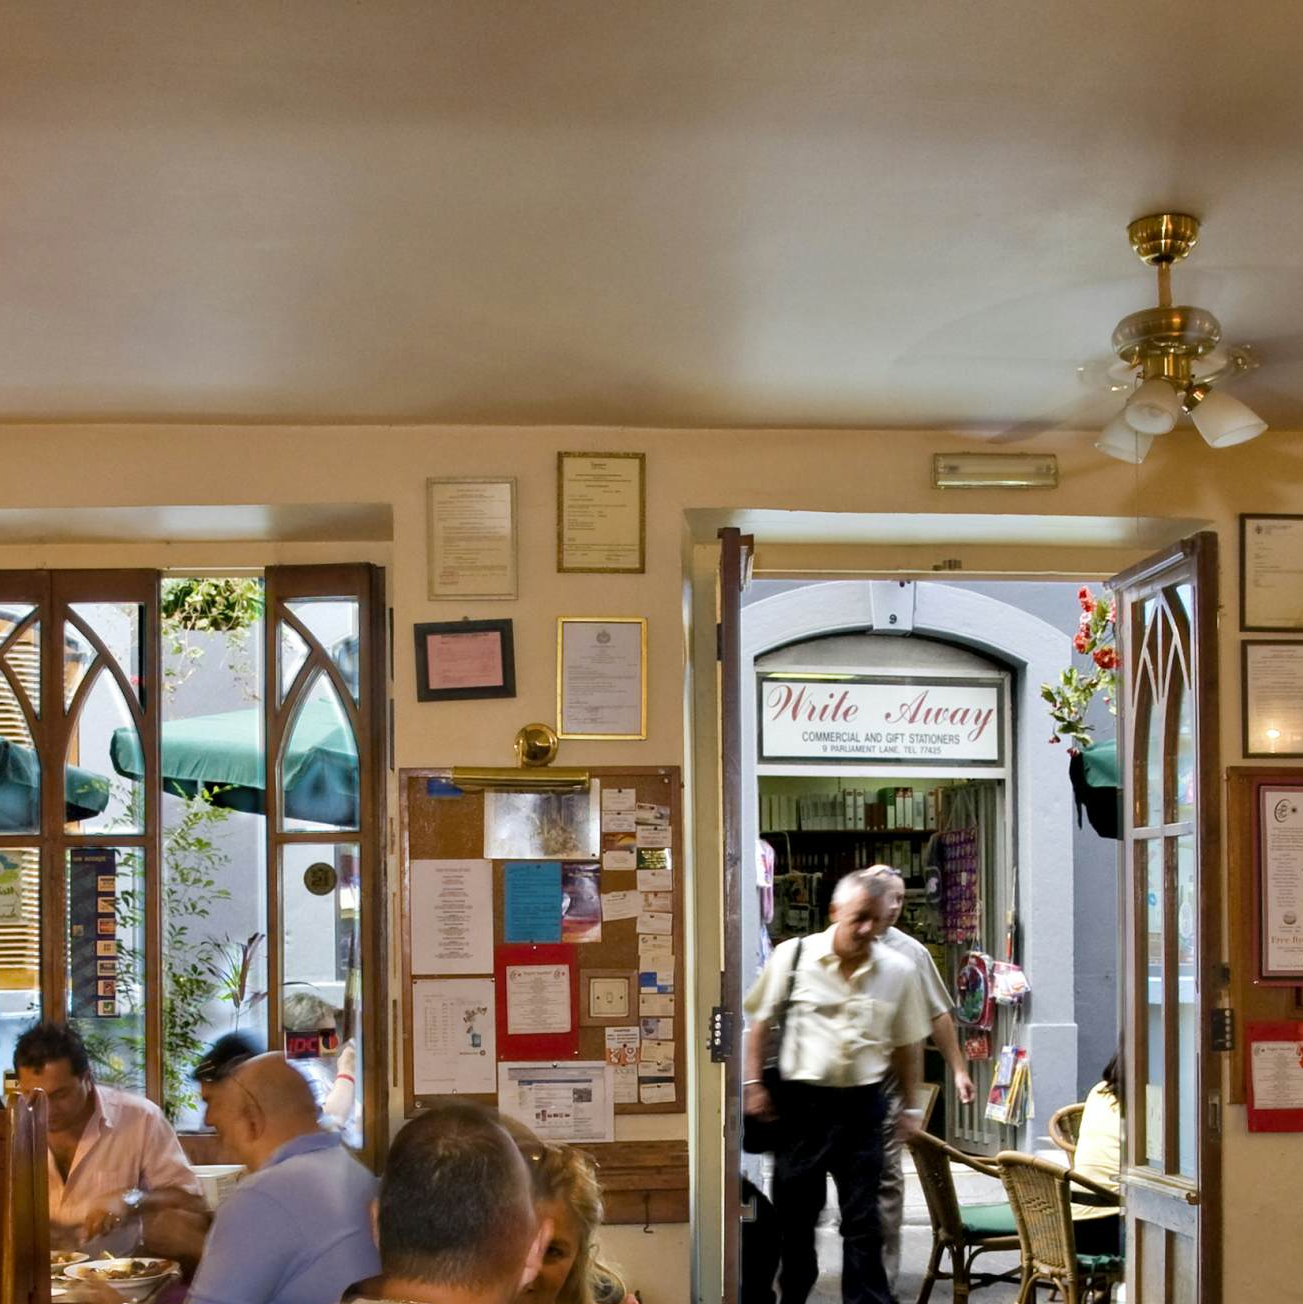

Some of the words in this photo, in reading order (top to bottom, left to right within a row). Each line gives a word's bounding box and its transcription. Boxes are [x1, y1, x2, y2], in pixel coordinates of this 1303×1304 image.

[889, 614, 898, 624] 9
[767, 684, 859, 723] Write
[884, 689, 996, 743] Away
[802, 731, 861, 743] COMMERCIAL
[864, 732, 883, 743] AND
[886, 733, 904, 744] GIFT
[909, 733, 960, 745] STATIONERS
[822, 744, 828, 752] 9
[830, 744, 876, 753] PARLIAMENT
[904, 745, 917, 754] TEL
